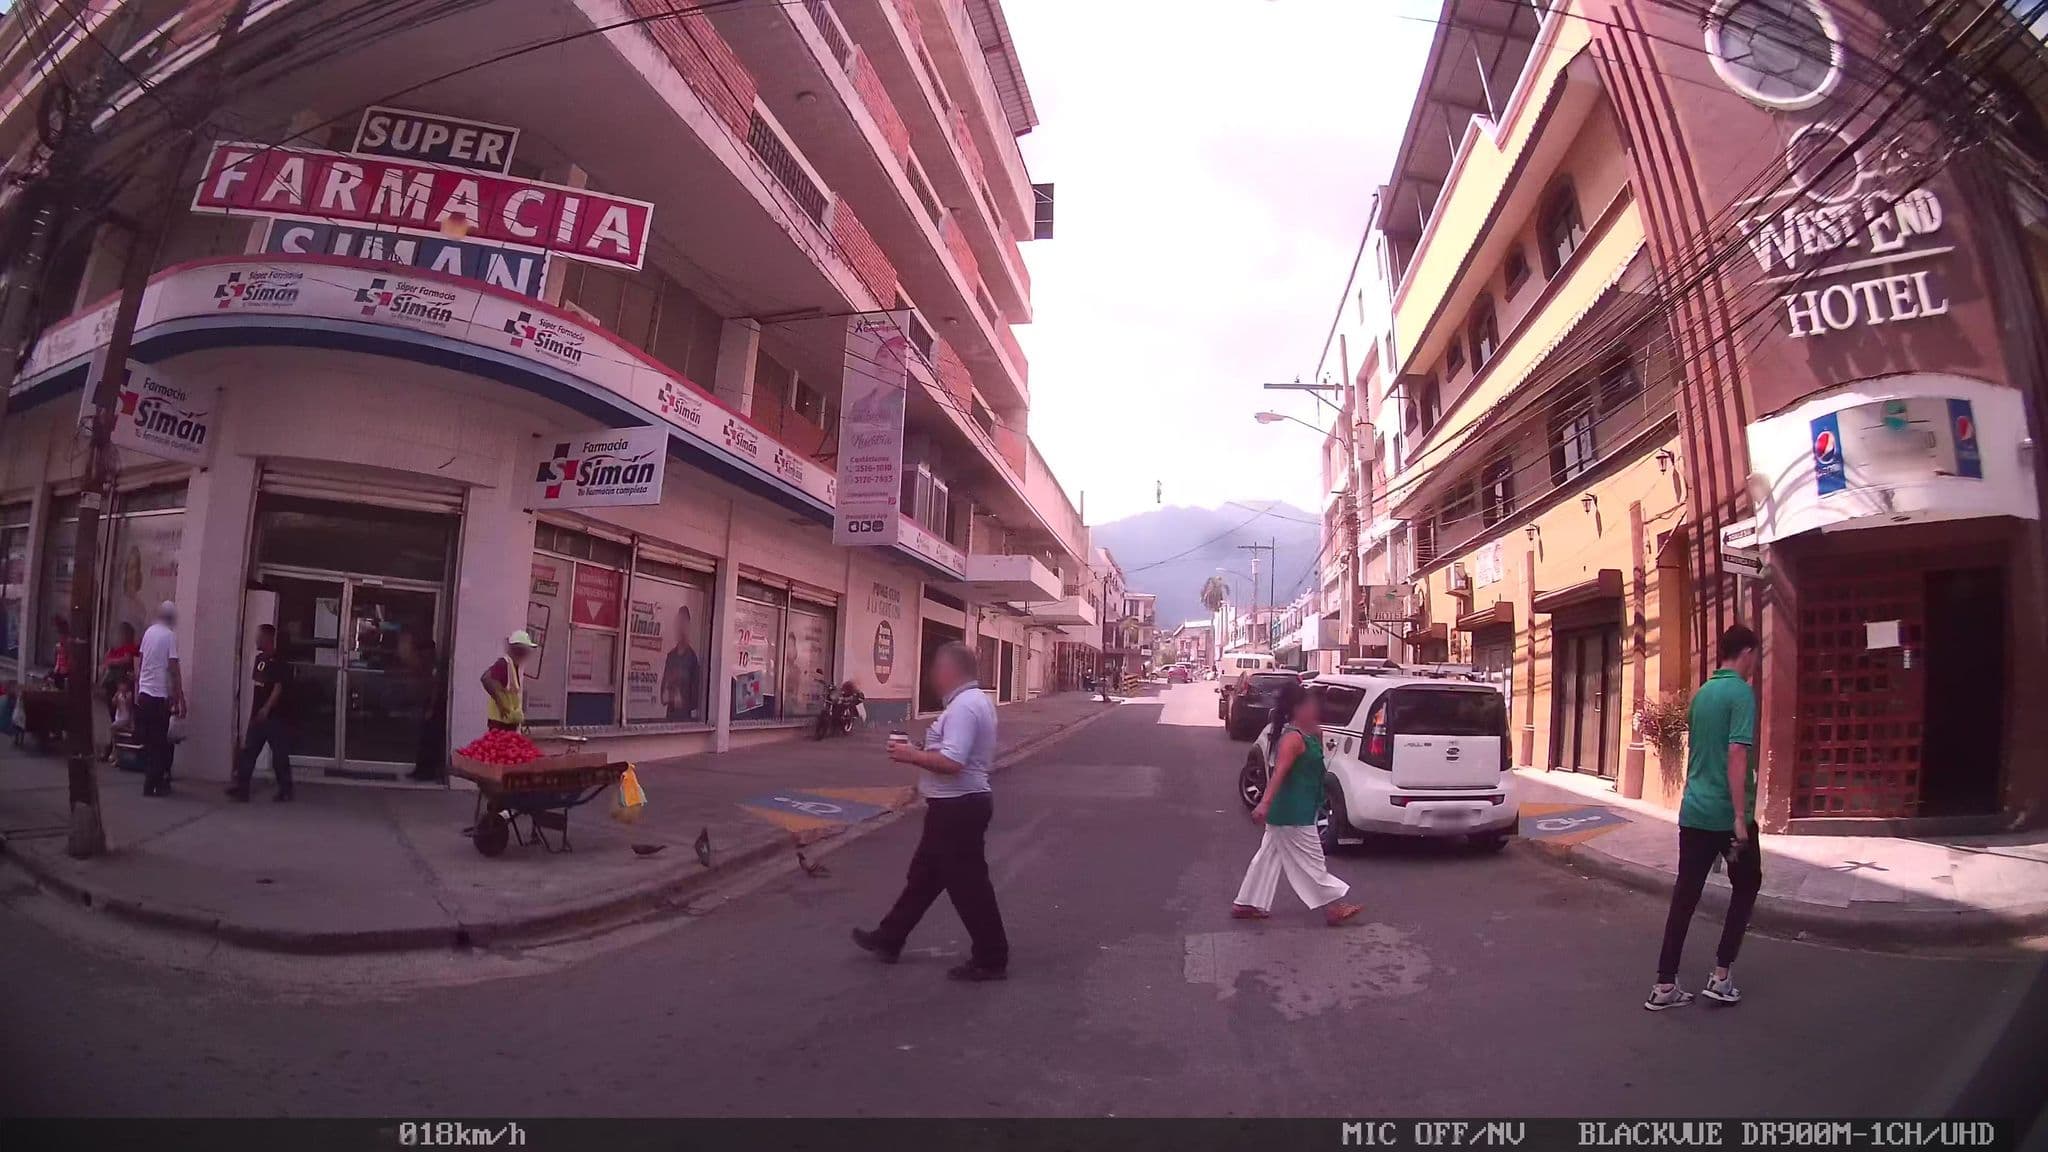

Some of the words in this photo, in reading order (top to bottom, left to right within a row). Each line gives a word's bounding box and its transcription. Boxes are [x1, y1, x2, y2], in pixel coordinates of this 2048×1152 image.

[363, 115, 505, 166] SUPER
[212, 152, 632, 255] FARMACIA
[1860, 187, 1944, 253] END
[419, 286, 456, 301] Farmacia
[1779, 270, 1950, 339] HOTEL
[134, 400, 207, 445] Simán
[582, 438, 629, 453] Farmacia
[576, 455, 656, 486] Simán
